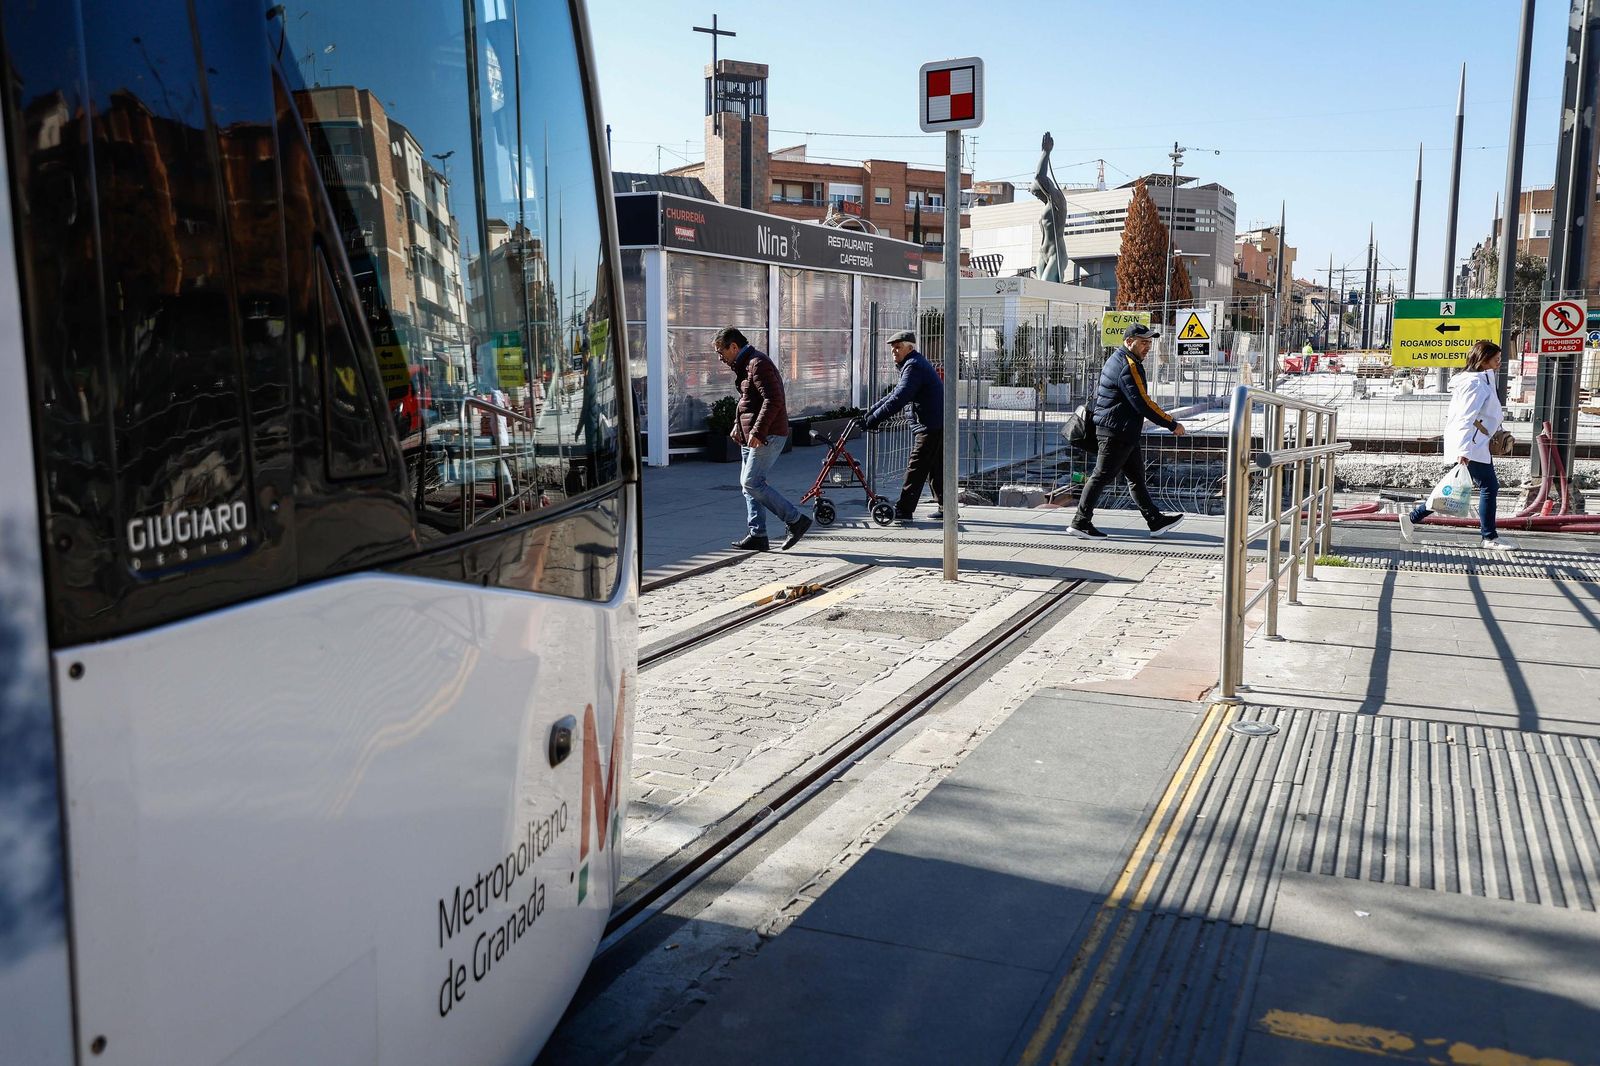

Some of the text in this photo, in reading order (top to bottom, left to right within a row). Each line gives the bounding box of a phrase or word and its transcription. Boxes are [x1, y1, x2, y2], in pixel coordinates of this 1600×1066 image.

[757, 224, 788, 257] Nina
[827, 235, 874, 253] RESTAURANTE
[840, 253, 874, 268] CAFETERÍA
[1123, 315, 1139, 323] SAN
[1445, 339, 1493, 347] DISCUL
[127, 501, 247, 552] GIUGIARO
[133, 535, 248, 571] DESIGN
[439, 801, 568, 949] Metropolitano
[439, 876, 545, 1018] de Granada
